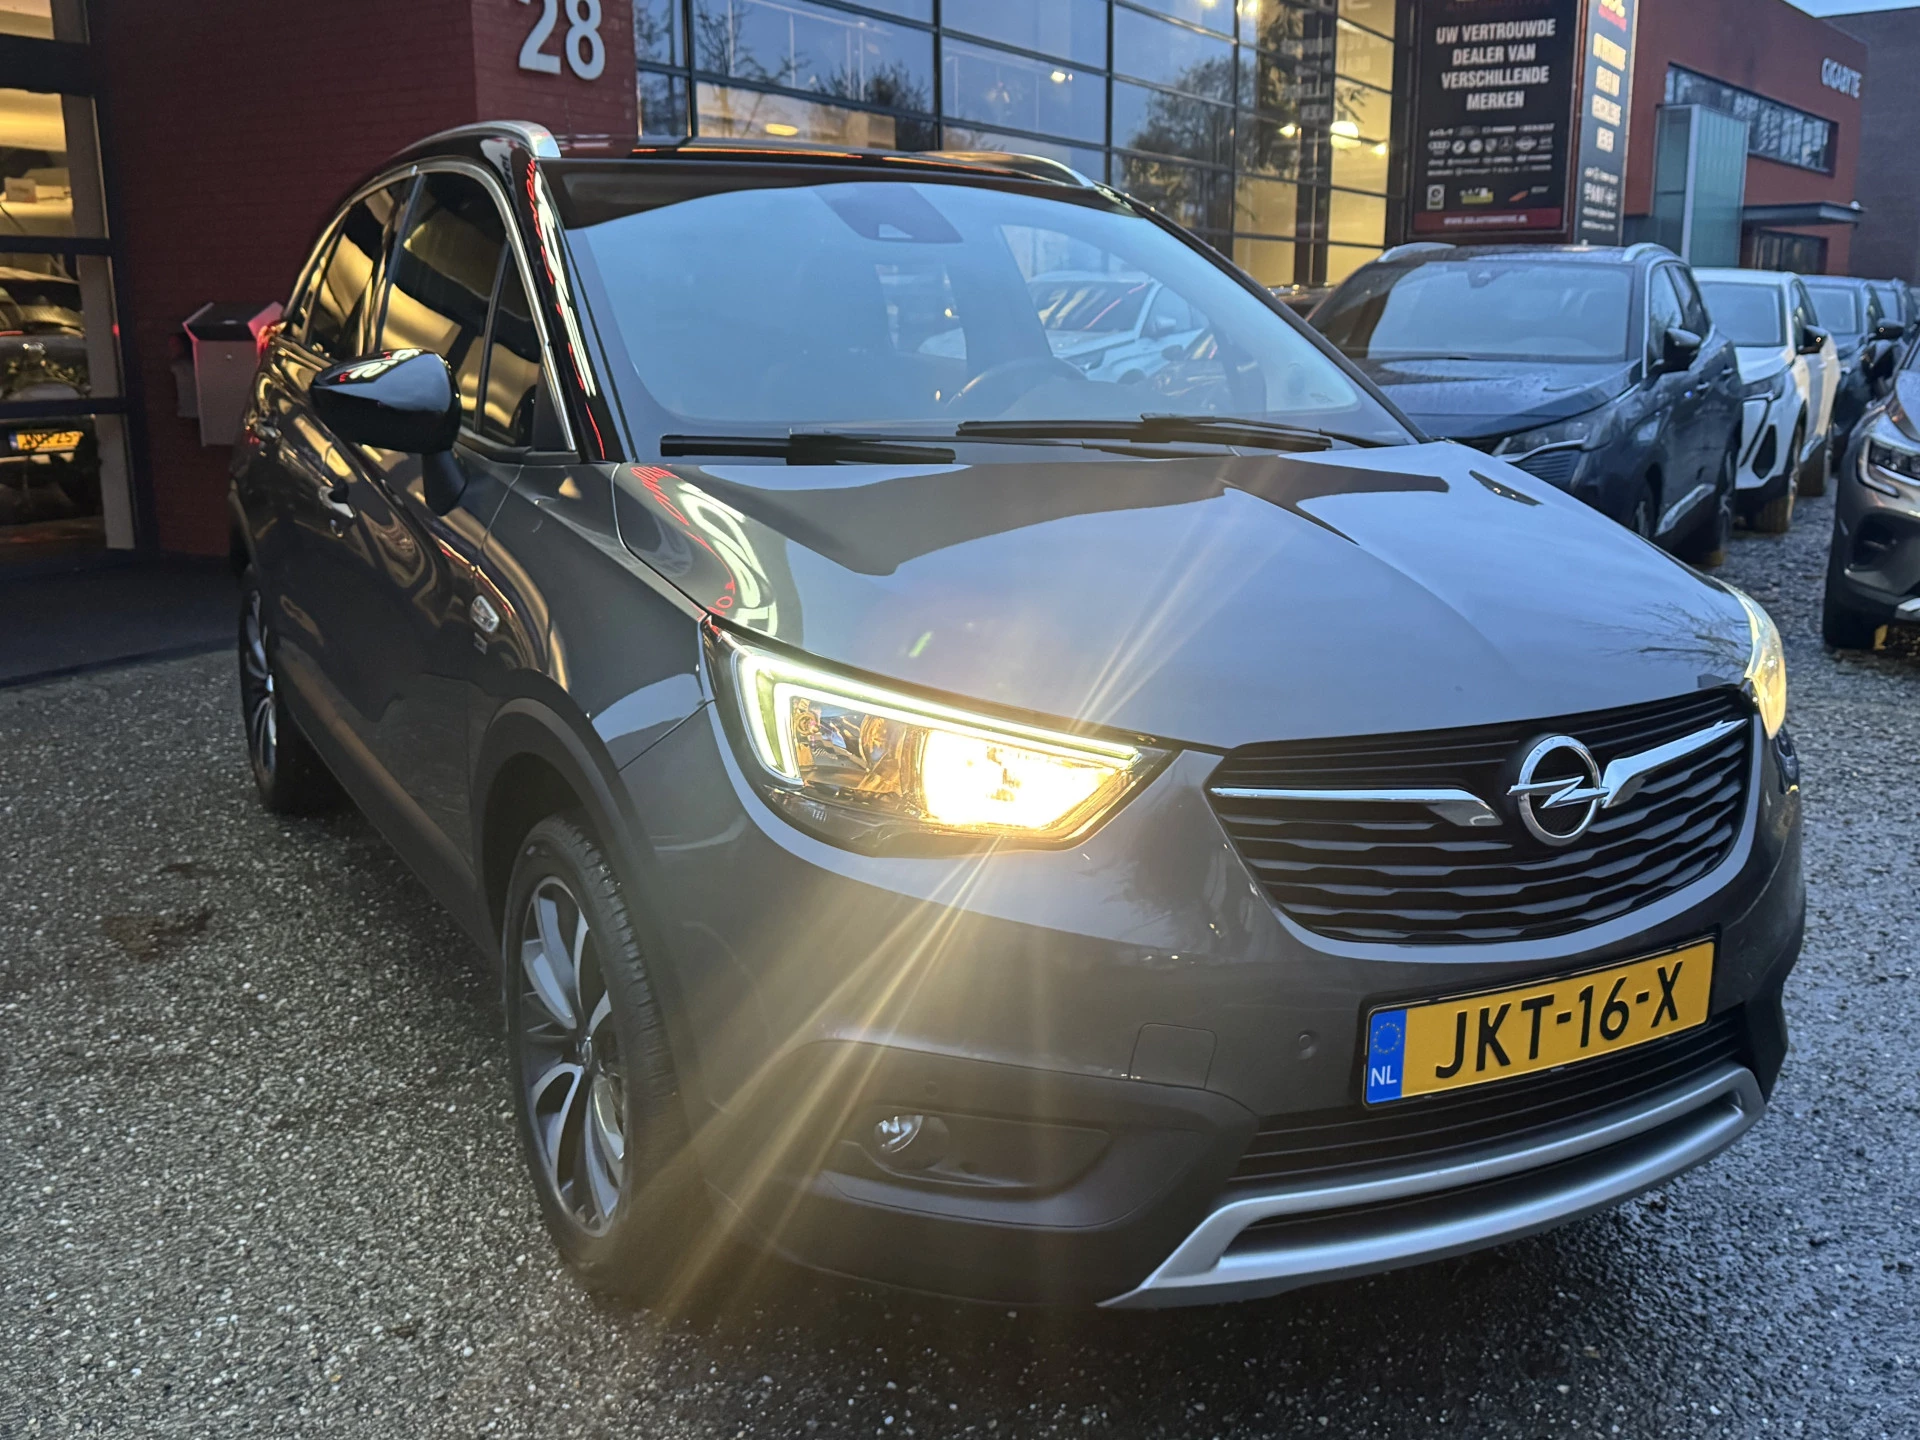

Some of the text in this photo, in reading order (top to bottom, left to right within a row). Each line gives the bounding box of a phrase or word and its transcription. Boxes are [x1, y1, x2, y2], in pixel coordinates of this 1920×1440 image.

[518, 0, 605, 80] 28
[1436, 19, 1556, 44] UW VERTROUWDE
[1453, 44, 1536, 66] DEALER VAN
[1441, 66, 1550, 89] VERSCHILLENDE
[1466, 91, 1525, 111] MERKEN
[1435, 961, 1683, 1079] JKT-16-X
[1370, 1065, 1397, 1087] NL
